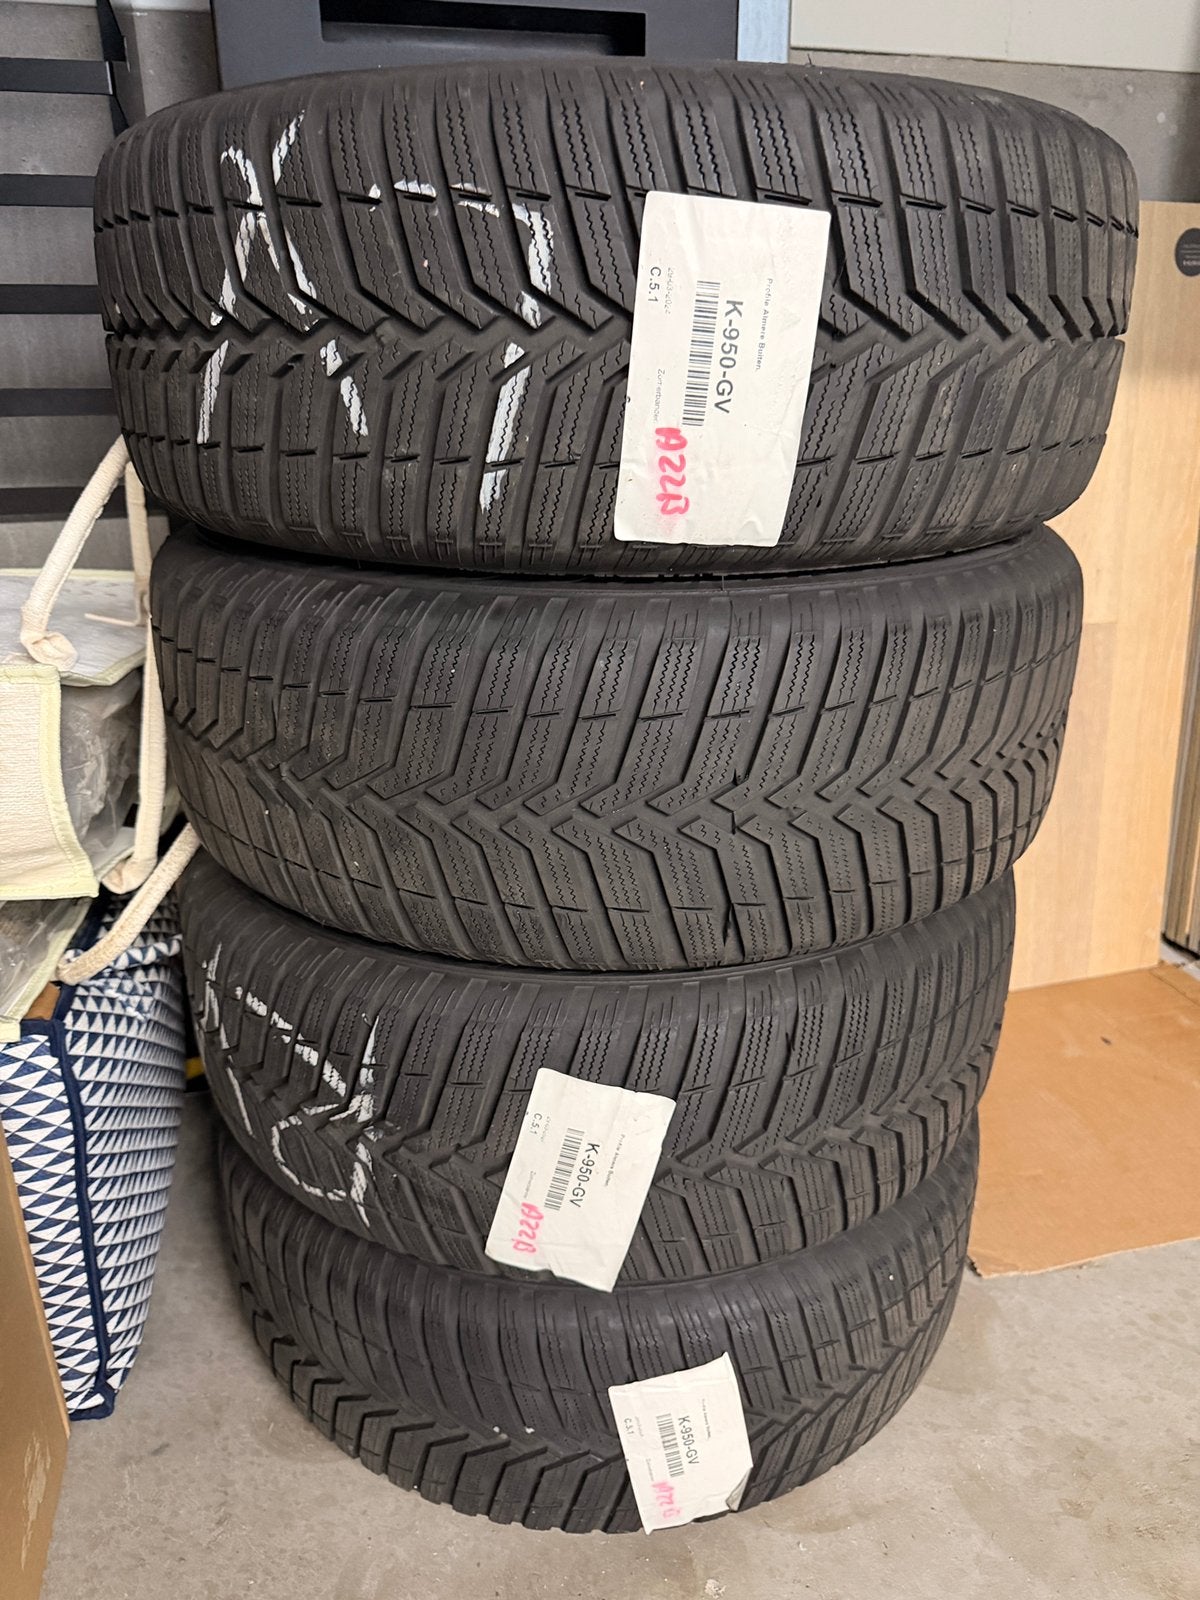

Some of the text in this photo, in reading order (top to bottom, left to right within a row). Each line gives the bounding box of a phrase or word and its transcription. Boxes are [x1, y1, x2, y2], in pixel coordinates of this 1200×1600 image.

[648, 266, 661, 303] C.5.1
[763, 278, 773, 306] Profile
[759, 309, 769, 341] Almere
[714, 300, 743, 414] K-950-GV
[529, 1112, 543, 1135] C.5.1
[570, 1142, 600, 1208] K-950-GV
[678, 1415, 700, 1465] K-950-GV
